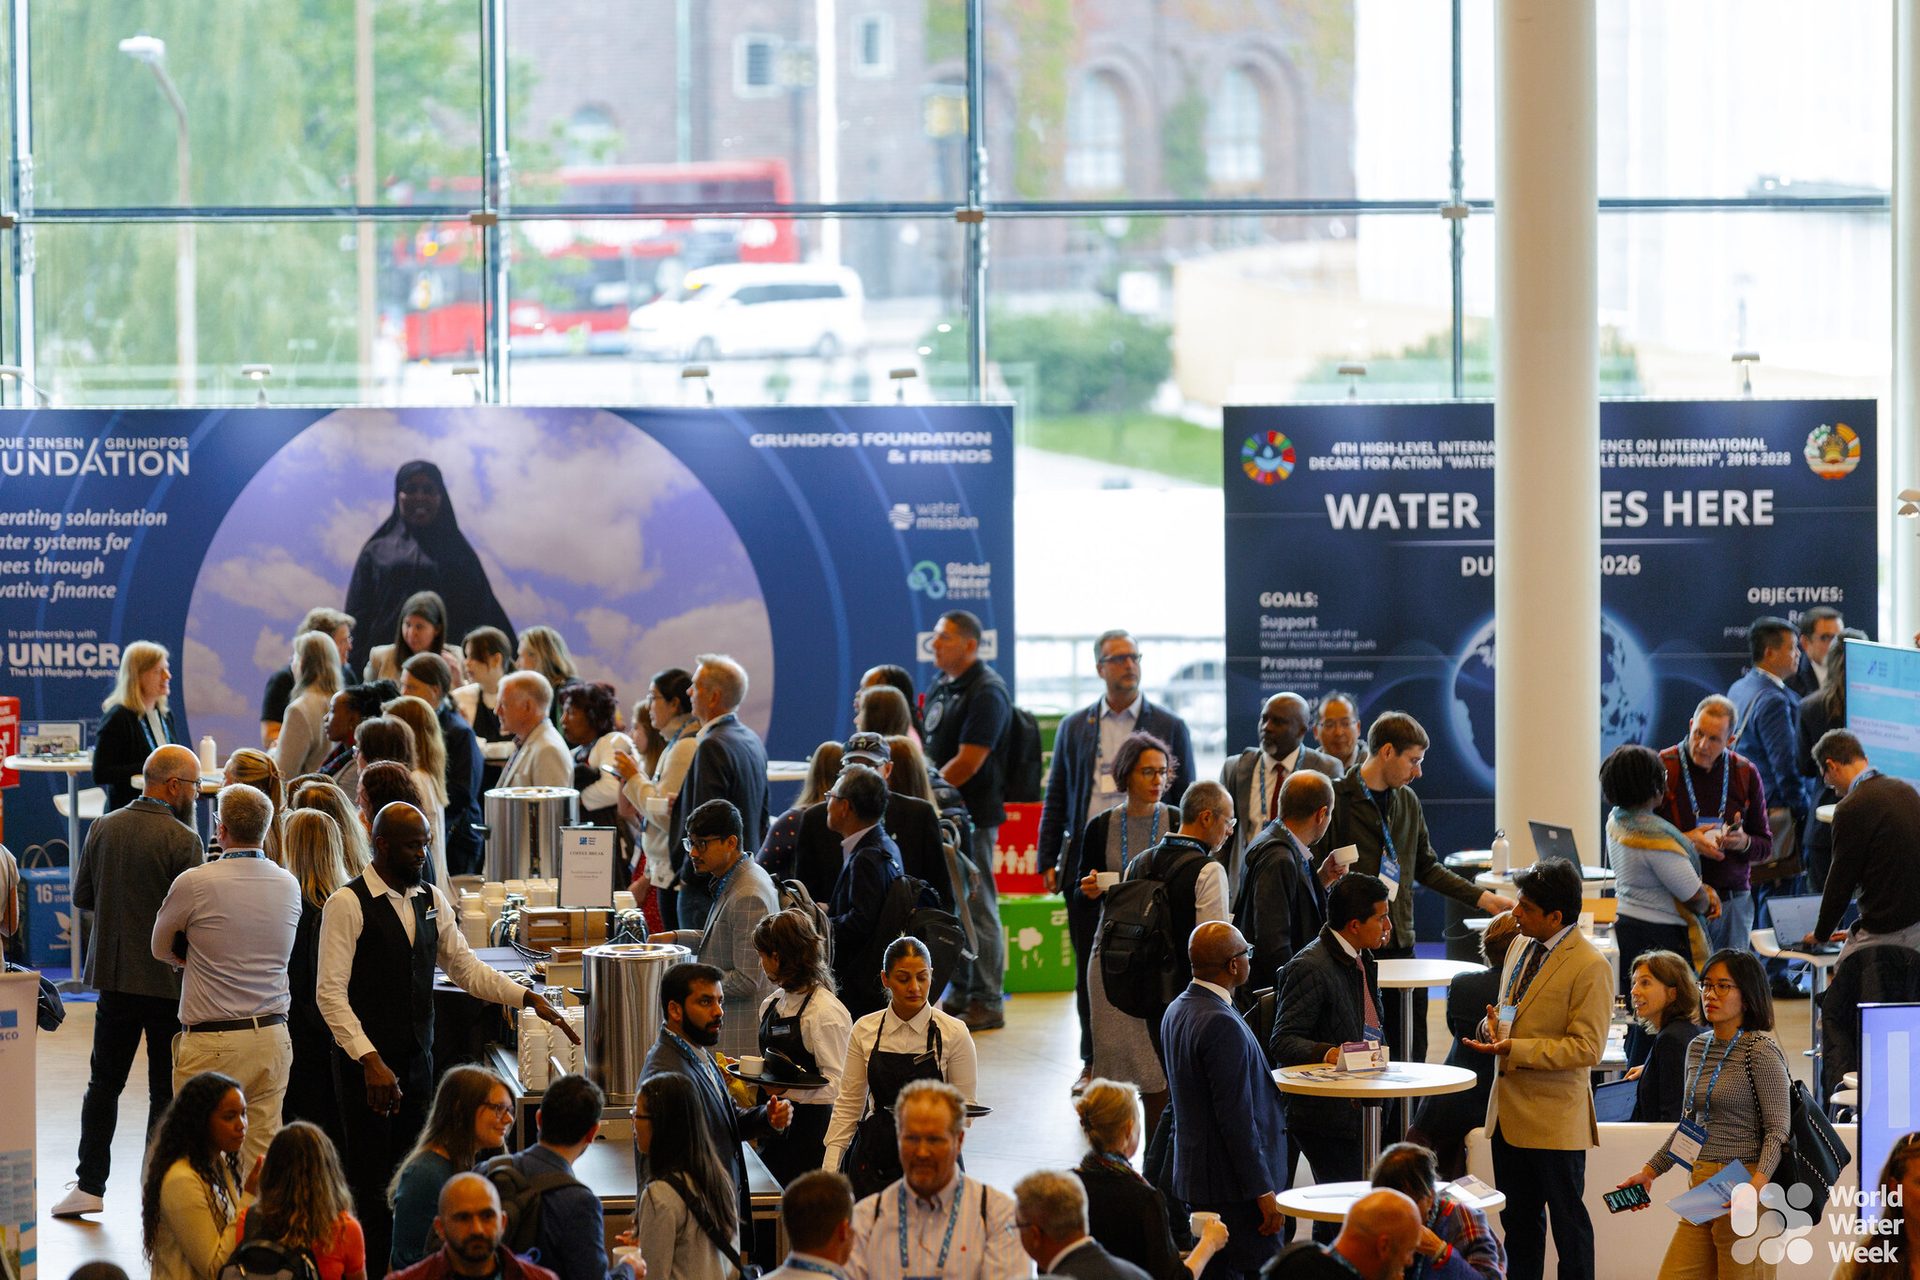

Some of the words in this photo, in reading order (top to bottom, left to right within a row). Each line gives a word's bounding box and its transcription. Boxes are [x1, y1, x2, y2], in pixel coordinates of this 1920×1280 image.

[28, 437, 84, 449] JENSEN
[105, 437, 188, 450] GRUNDFOS
[750, 433, 859, 447] GRUNDFOS
[862, 432, 993, 446] FOUNDATION
[1331, 442, 1358, 455] 4TH
[1360, 441, 1436, 455] HIGH-LEVEL
[1636, 439, 1658, 452] ON
[1660, 437, 1768, 452] INTERNATIONAL
[2, 437, 189, 476] UNDATION
[887, 449, 905, 464] &
[909, 449, 993, 463] FRIENDS
[1309, 456, 1361, 470] DECADE
[1363, 456, 1390, 470] FOR
[1391, 456, 1443, 470] ACTION
[1727, 452, 1792, 466] 2018-2028
[65, 508, 168, 526] solarisation
[915, 502, 960, 516] water
[1324, 493, 1482, 530] WATER
[1663, 489, 1774, 526] HERE
[916, 514, 979, 530] mission
[33, 533, 102, 555] systems
[102, 532, 132, 555] for
[0, 560, 31, 576] ees
[34, 556, 105, 579] through
[1600, 555, 1641, 575] 026
[49, 580, 117, 603] finance
[1259, 592, 1319, 608] GOALS:
[1747, 586, 1843, 606] OBJECTIVES:
[1260, 615, 1318, 630] Support
[8, 629, 18, 639] In
[20, 629, 74, 640] partnership
[76, 629, 97, 639] with
[8, 643, 120, 667] UNHCR
[1260, 656, 1323, 670] Promote
[10, 668, 27, 677] The
[28, 668, 43, 677] UN
[45, 668, 84, 679] Refugee
[35, 883, 53, 904] 16
